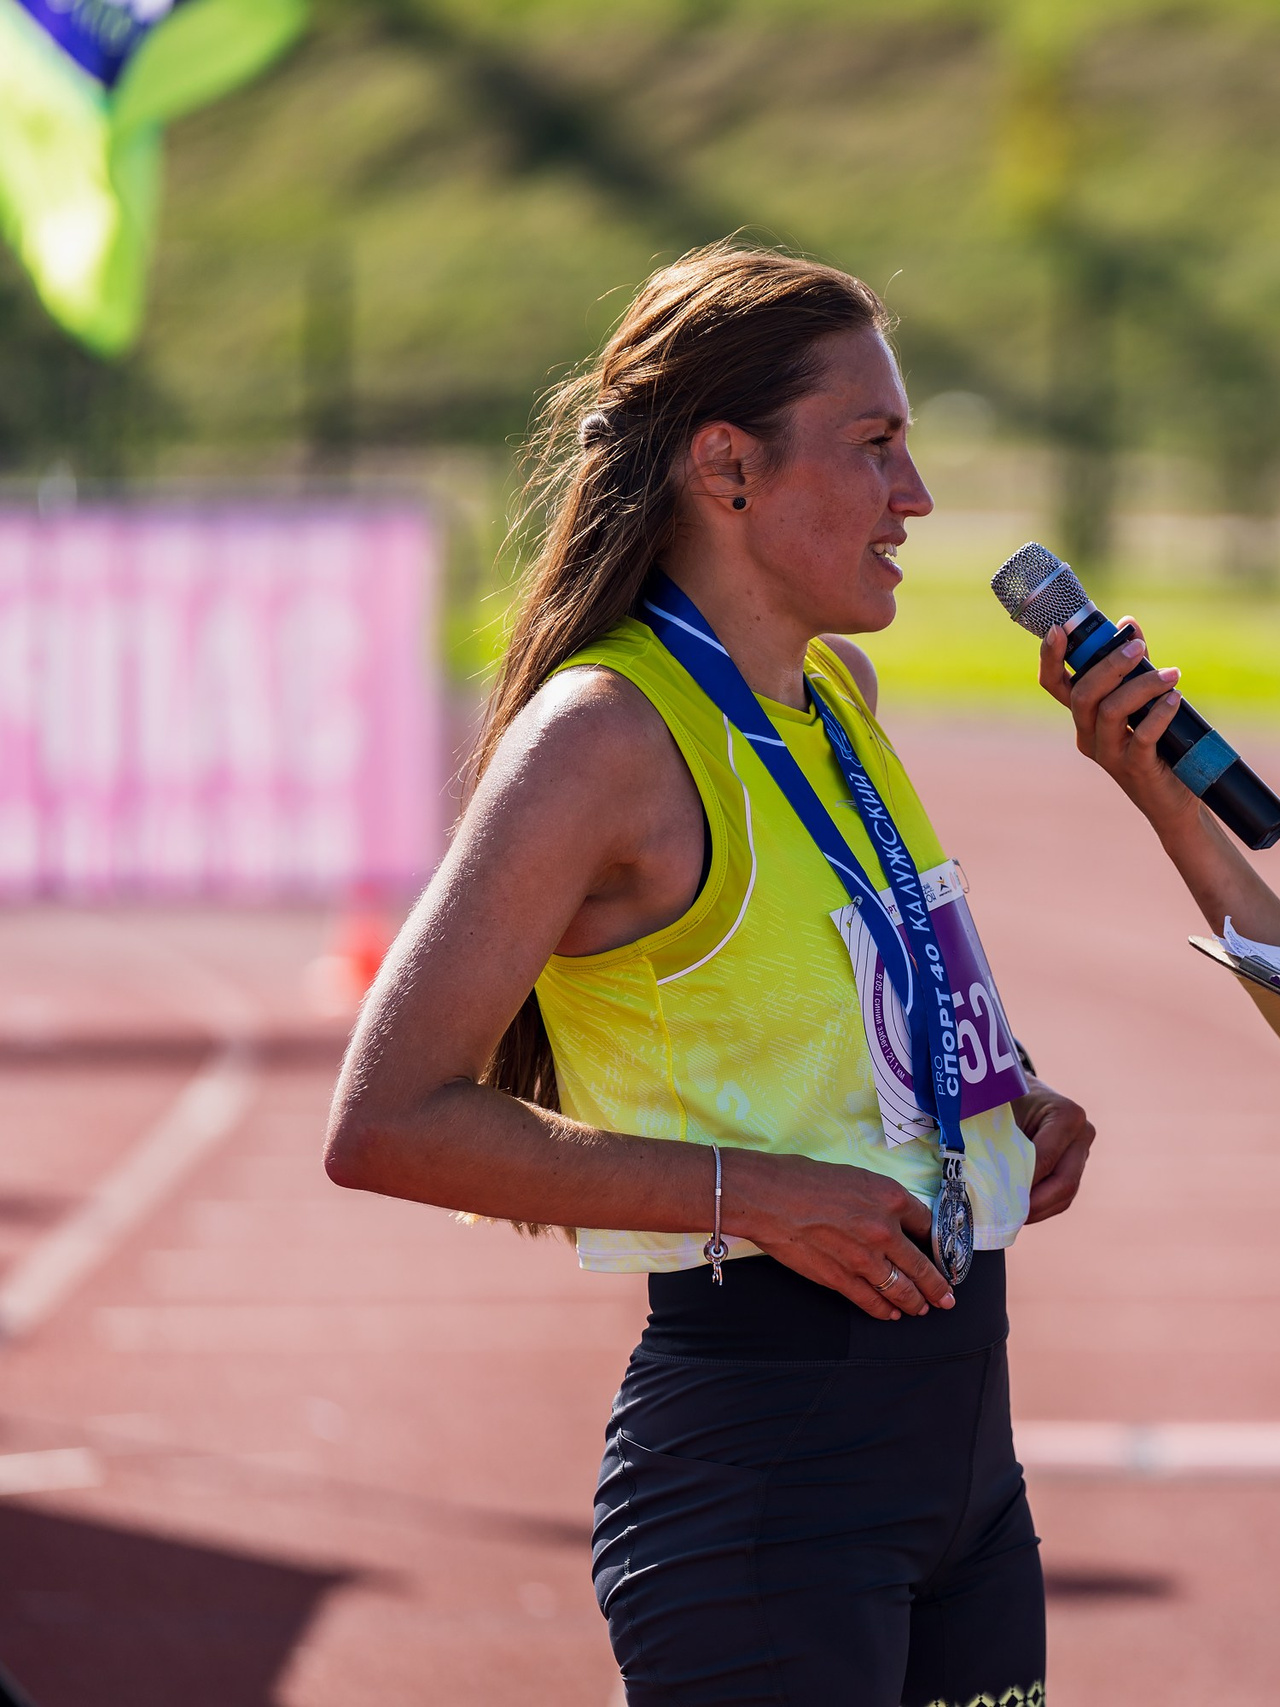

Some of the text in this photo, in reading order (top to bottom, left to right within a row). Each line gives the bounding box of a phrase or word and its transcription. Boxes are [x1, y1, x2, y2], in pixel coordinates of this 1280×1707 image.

[849, 772, 931, 933] КАЛУЖСКИЙ
[874, 997, 882, 1025] синий
[876, 1025, 888, 1049] забег
[935, 987, 960, 1097] СПОРТ
[933, 1055, 946, 1096] PRO
